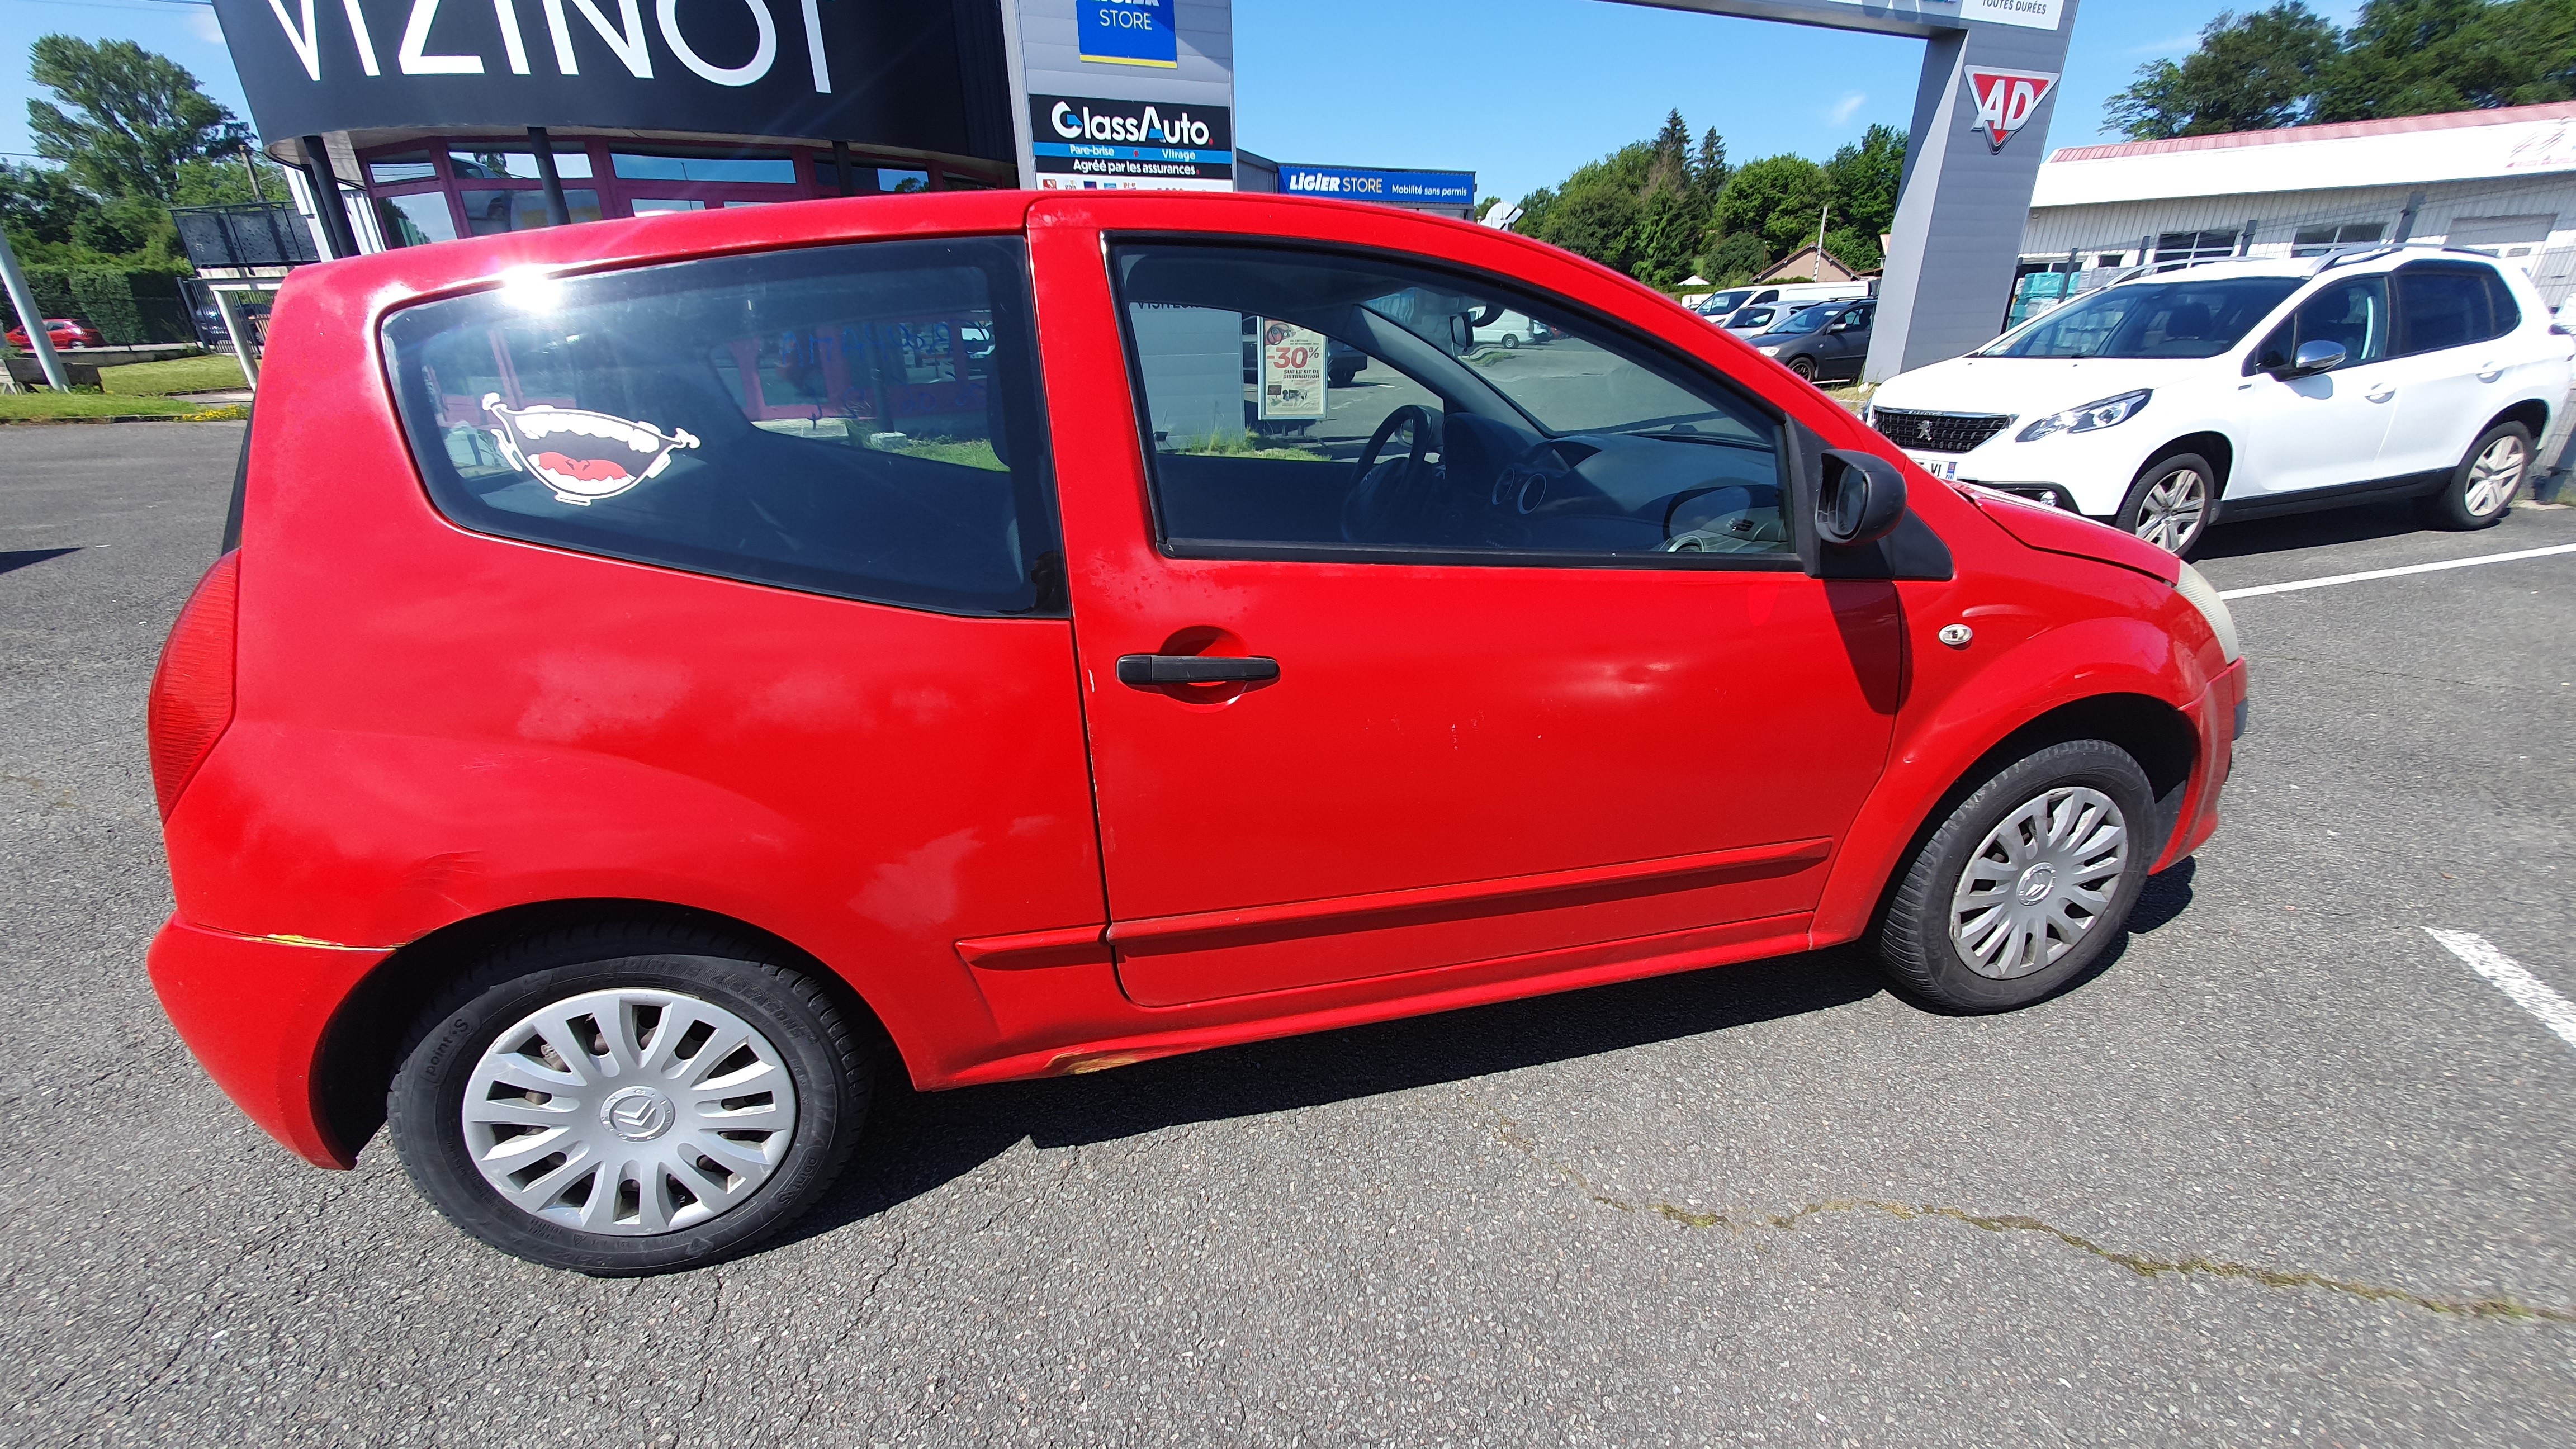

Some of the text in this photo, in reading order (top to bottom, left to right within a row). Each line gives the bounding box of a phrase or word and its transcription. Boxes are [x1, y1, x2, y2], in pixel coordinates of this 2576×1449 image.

[2015, 1, 2047, 15] DURÉES
[1100, 9, 1153, 30] STORE
[1971, 79, 2034, 131] AD
[1069, 144, 1115, 157] Pare-brise
[1162, 149, 1196, 162] Vitrage
[1073, 159, 1106, 173] Agréé
[1107, 162, 1126, 174] par
[1126, 161, 1141, 173] les
[1343, 177, 1382, 193] STORE
[1392, 184, 1423, 195] Mobilité
[1424, 187, 1441, 196] sans
[1442, 186, 1467, 197] permis
